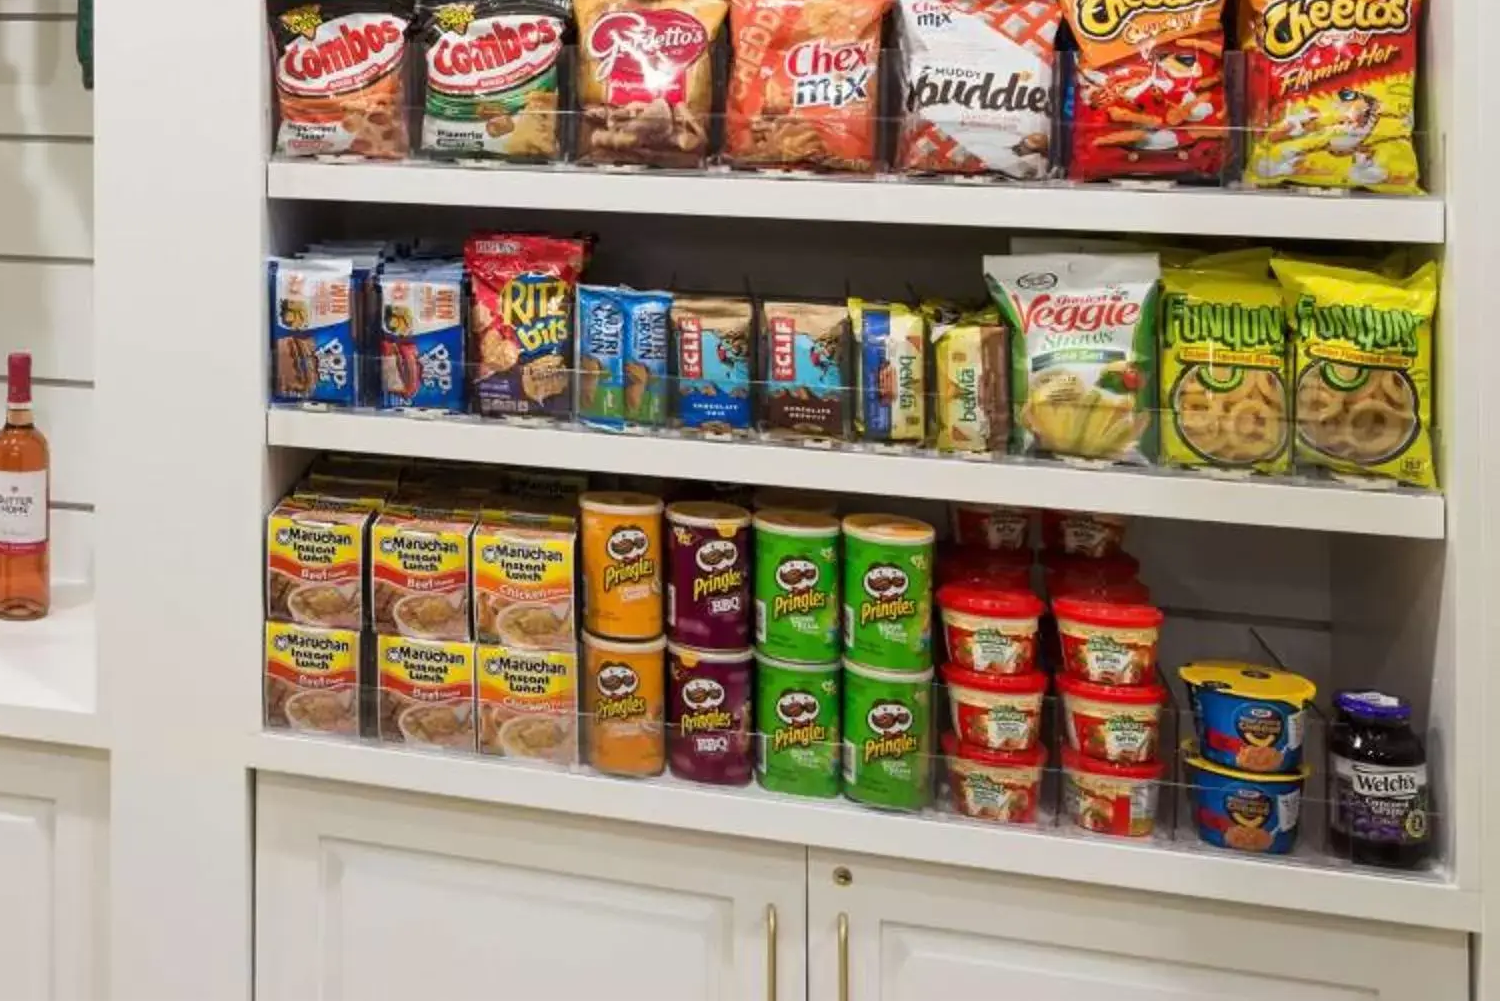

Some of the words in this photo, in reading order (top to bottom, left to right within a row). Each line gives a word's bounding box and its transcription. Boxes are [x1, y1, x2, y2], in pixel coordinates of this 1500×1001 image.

[284, 20, 401, 80] Combos
[433, 18, 558, 76] Combos
[786, 37, 874, 78] Chex
[1359, 44, 1400, 69] Hot
[501, 278, 568, 327] RITZ
[1011, 293, 1141, 336] Veggie
[288, 528, 353, 545] Maruchan
[393, 536, 459, 553] Maruchan
[496, 544, 563, 562] Maruchan
[604, 558, 654, 591] Pringles
[693, 569, 743, 602] Pringles
[773, 589, 826, 619] Pringles
[860, 598, 917, 626] Pringles
[286, 633, 350, 652] Maruchan
[400, 646, 465, 665] Maruchan
[498, 657, 567, 676] Maruchan
[596, 697, 646, 723] Pringles
[680, 708, 732, 738] Pringles
[774, 725, 826, 752] Pringles
[864, 734, 918, 763] Pringles
[1356, 773, 1416, 793] Welch's
